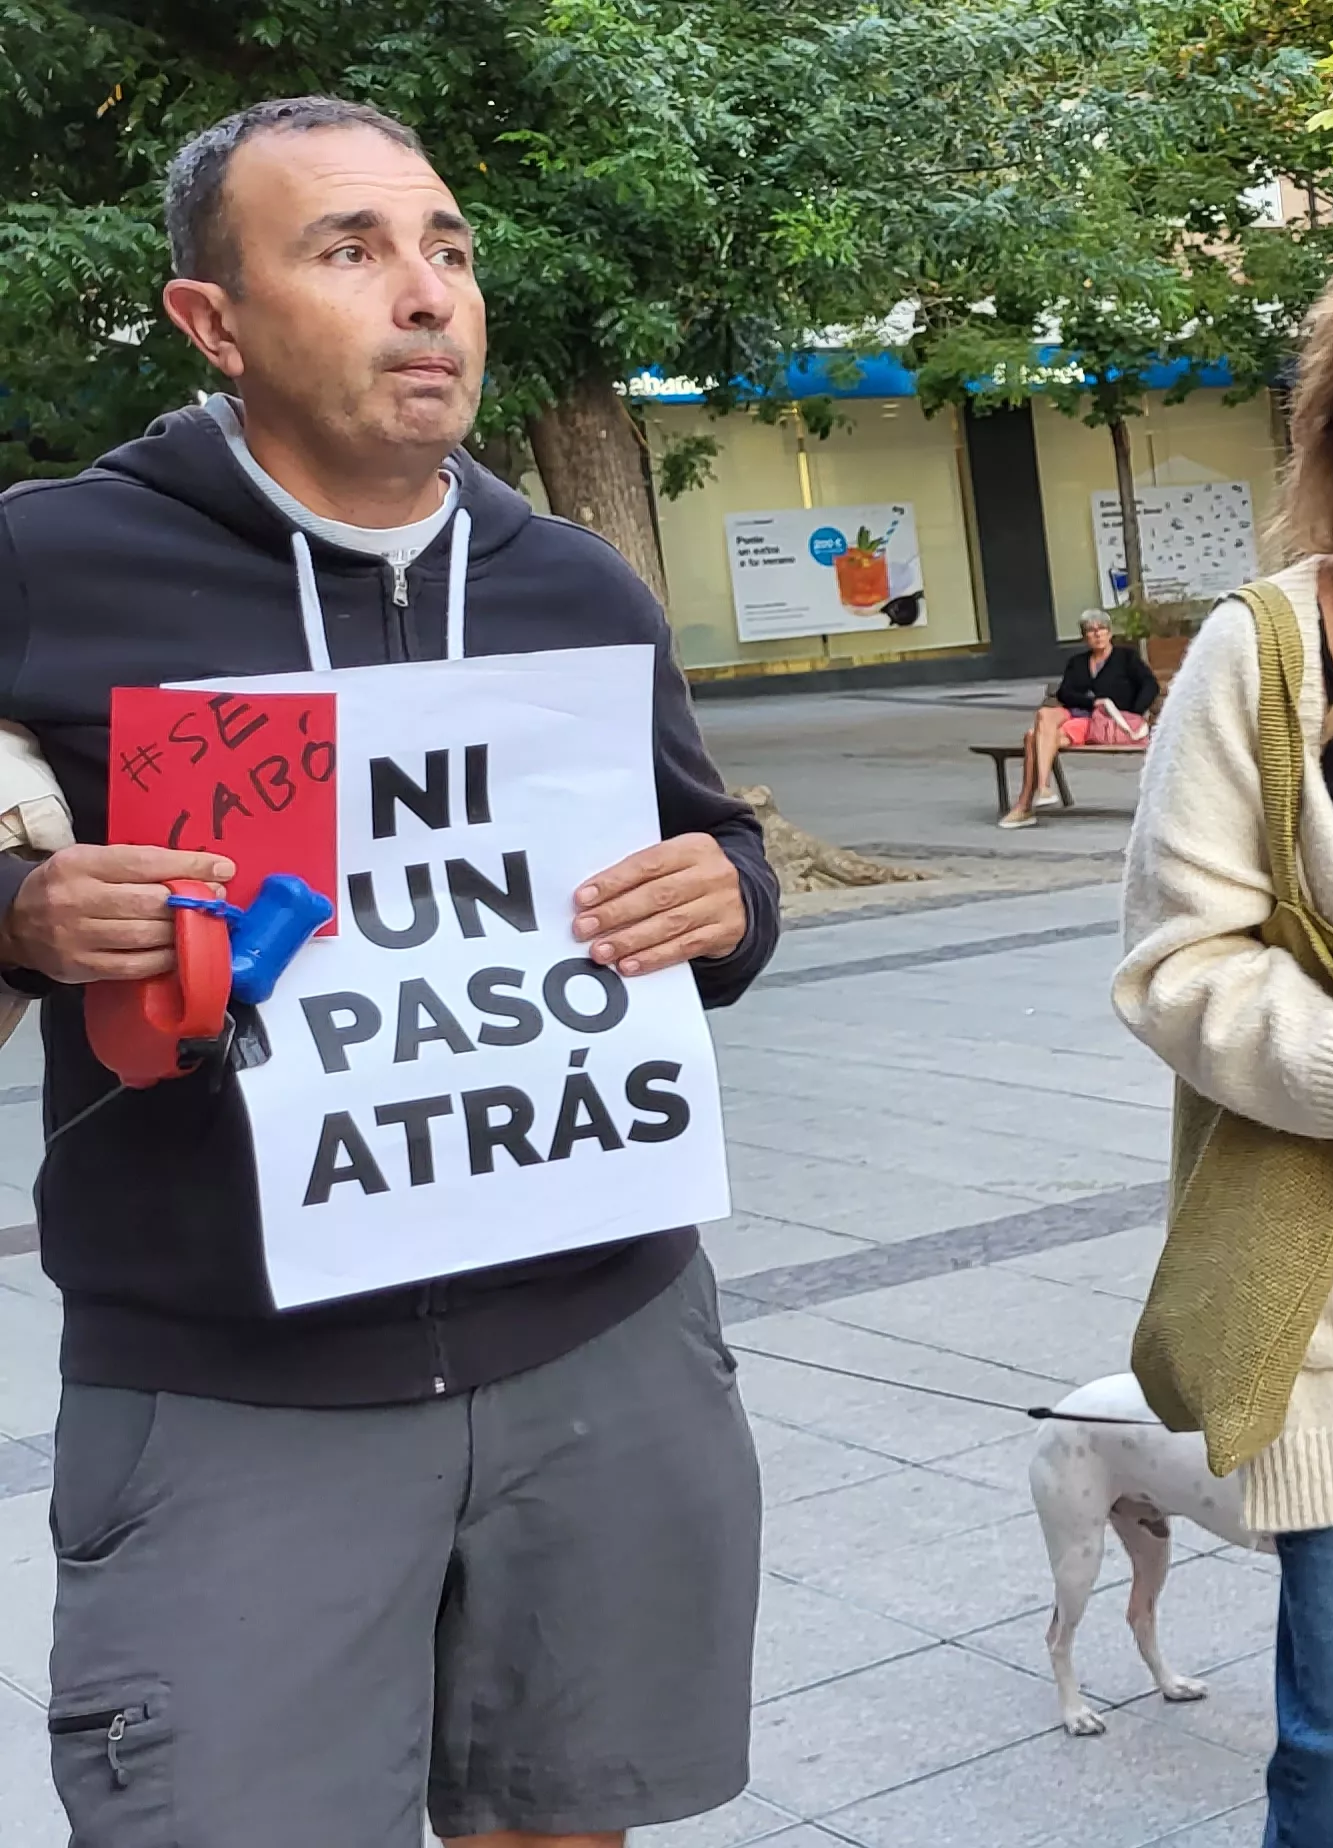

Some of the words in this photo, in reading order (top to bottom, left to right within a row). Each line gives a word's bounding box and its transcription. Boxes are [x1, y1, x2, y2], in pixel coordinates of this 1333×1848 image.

[120, 693, 269, 793] #SE
[167, 710, 336, 852] CABÓ
[369, 744, 493, 840] NI
[346, 849, 538, 949] UN
[299, 957, 629, 1074] PASO
[302, 1048, 691, 1207] ATRÁS
